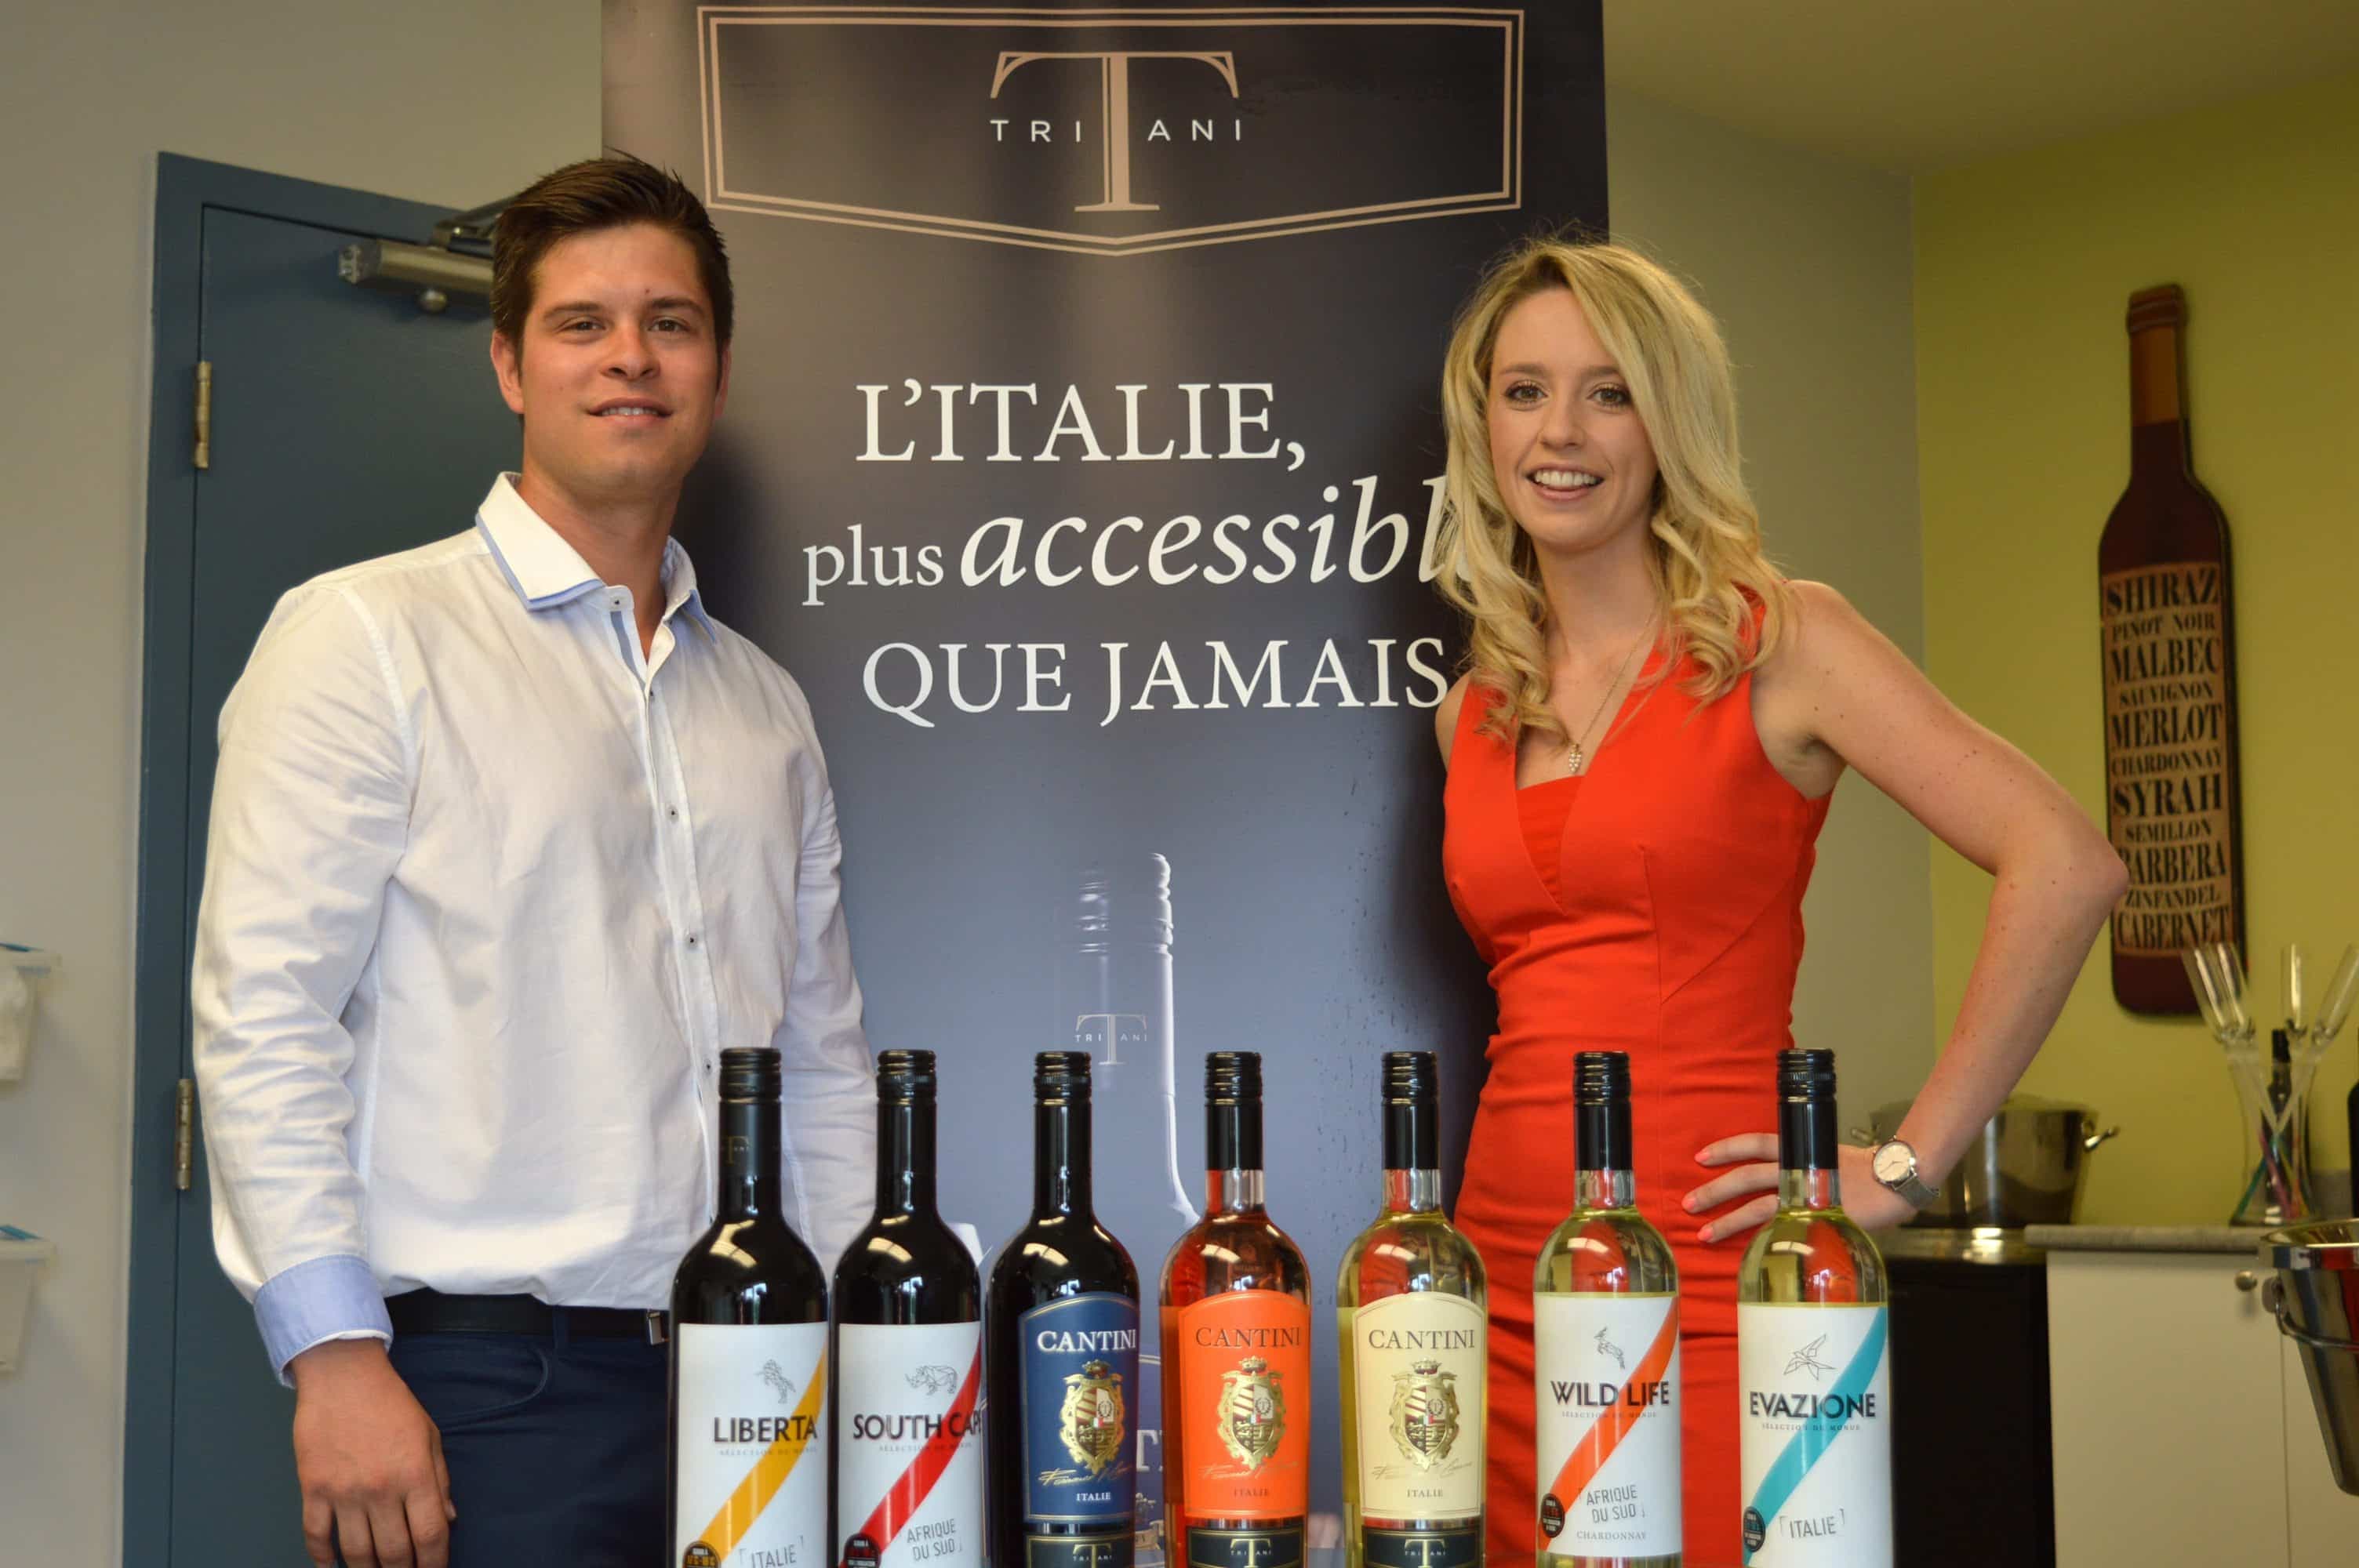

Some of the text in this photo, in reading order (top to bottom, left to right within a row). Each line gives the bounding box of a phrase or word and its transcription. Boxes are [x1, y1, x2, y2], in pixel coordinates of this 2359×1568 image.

[802, 474, 1471, 606] plus accessibl
[2107, 567, 2219, 616] SHIRAZ
[2112, 612, 2215, 642] PINOT NOIR
[2110, 637, 2220, 688] MALBEC
[863, 638, 1448, 729] QUE JAMAIS
[2120, 680, 2213, 707] SAUVIGNON
[2111, 703, 2223, 750] MERLOT
[2112, 749, 2222, 776] CHARDONNAY
[2114, 773, 2222, 817] SYRAH
[2125, 818, 2212, 843] SEMILLON
[2125, 884, 2221, 908] ZINFANDEL
[2118, 906, 2231, 949] CABERNET
[1037, 1329, 1136, 1352] CANTINI
[1195, 1327, 1301, 1348] CANTINI
[1369, 1329, 1475, 1349] CANTINI
[1550, 1380, 1670, 1406] WILD LIFE
[1750, 1391, 1876, 1418] EVAZIONE
[714, 1415, 817, 1443] LIBERTA
[853, 1414, 941, 1439] SOUTH
[1076, 1492, 1111, 1501] ITALIE
[1407, 1489, 1443, 1497] ITALIE
[1587, 1484, 1638, 1506] AFRIQUE
[1592, 1503, 1637, 1523] DU SUD
[907, 1518, 956, 1544] AFRIQUE
[1576, 1530, 1647, 1541] CHARDONNAY
[1790, 1515, 1837, 1539] ITALIE
[913, 1538, 955, 1562] DU SUD
